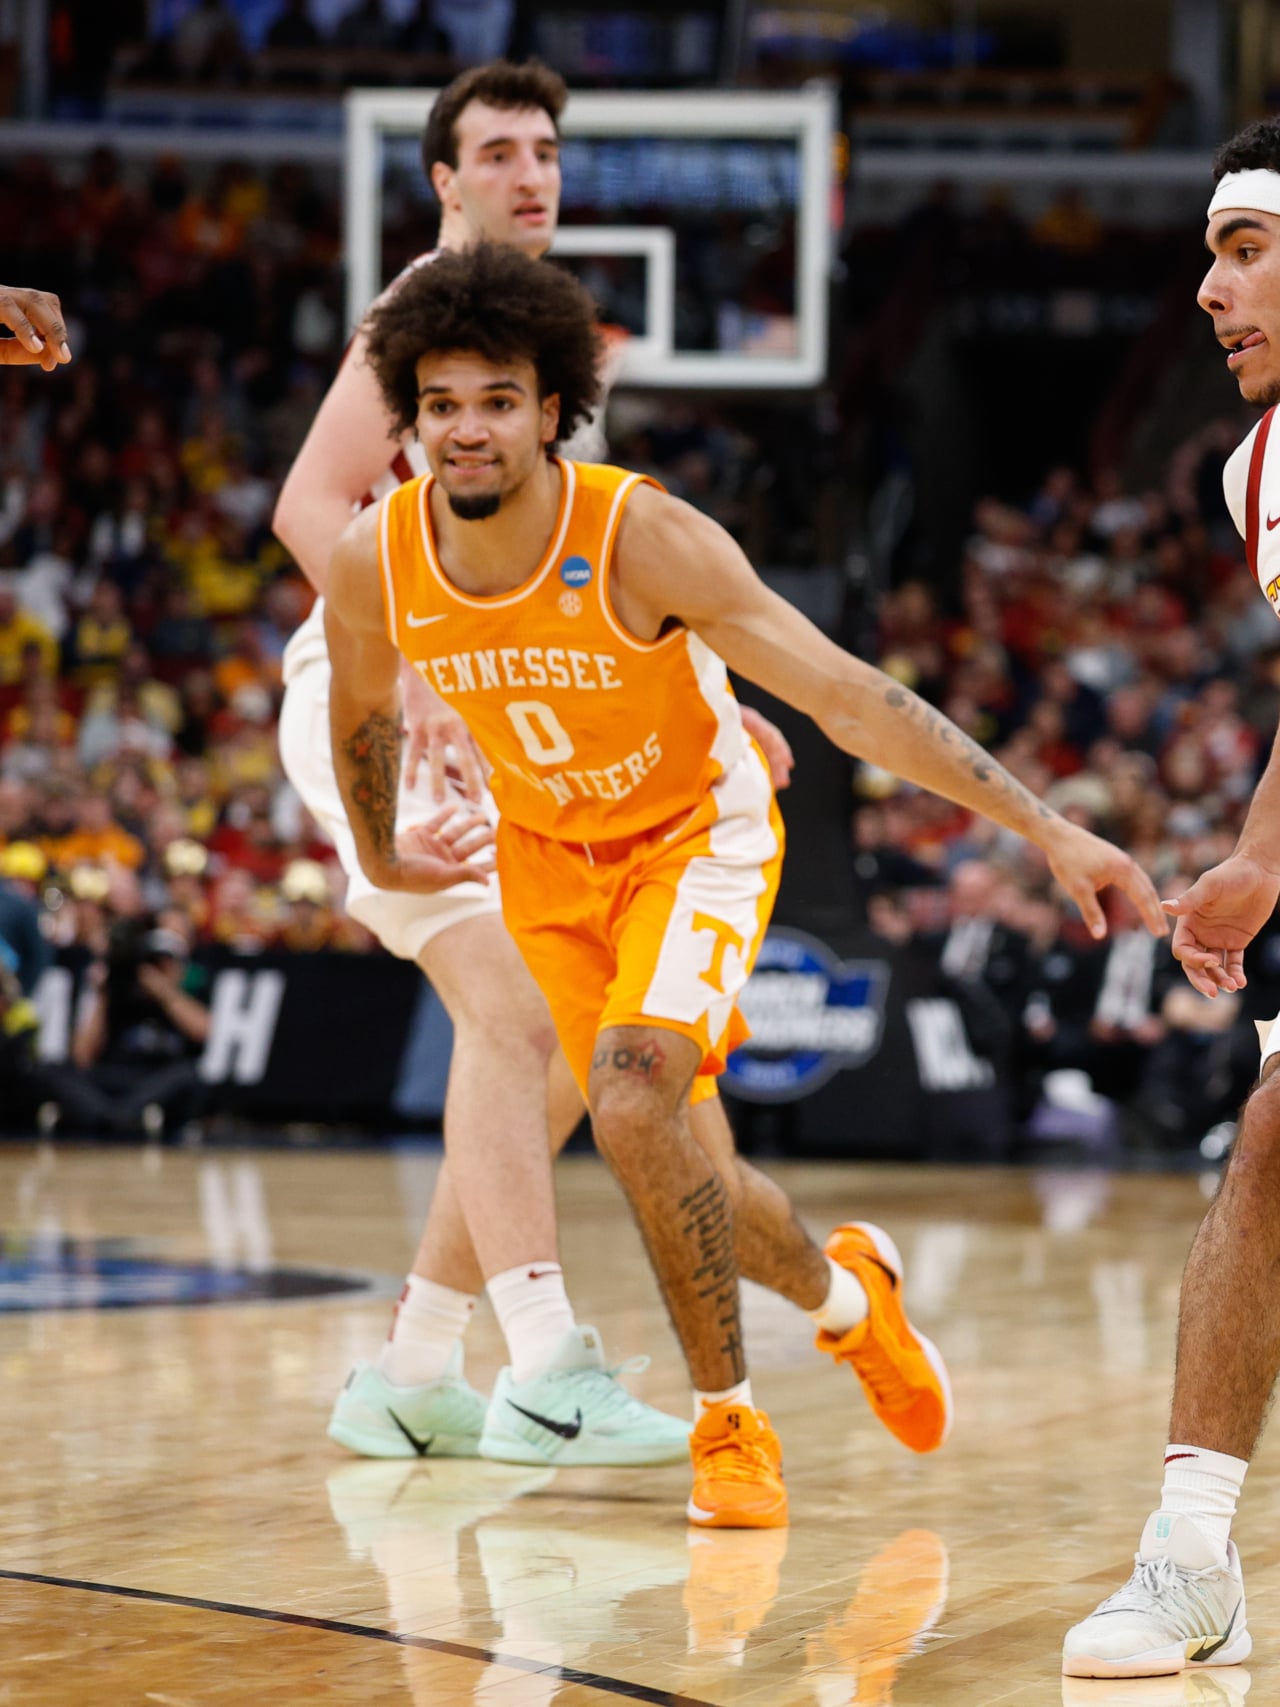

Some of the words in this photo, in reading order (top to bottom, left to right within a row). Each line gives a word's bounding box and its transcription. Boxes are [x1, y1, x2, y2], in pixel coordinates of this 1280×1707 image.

[413, 646, 622, 693] TENNESSEE
[504, 700, 575, 765] 0
[690, 910, 746, 995] T
